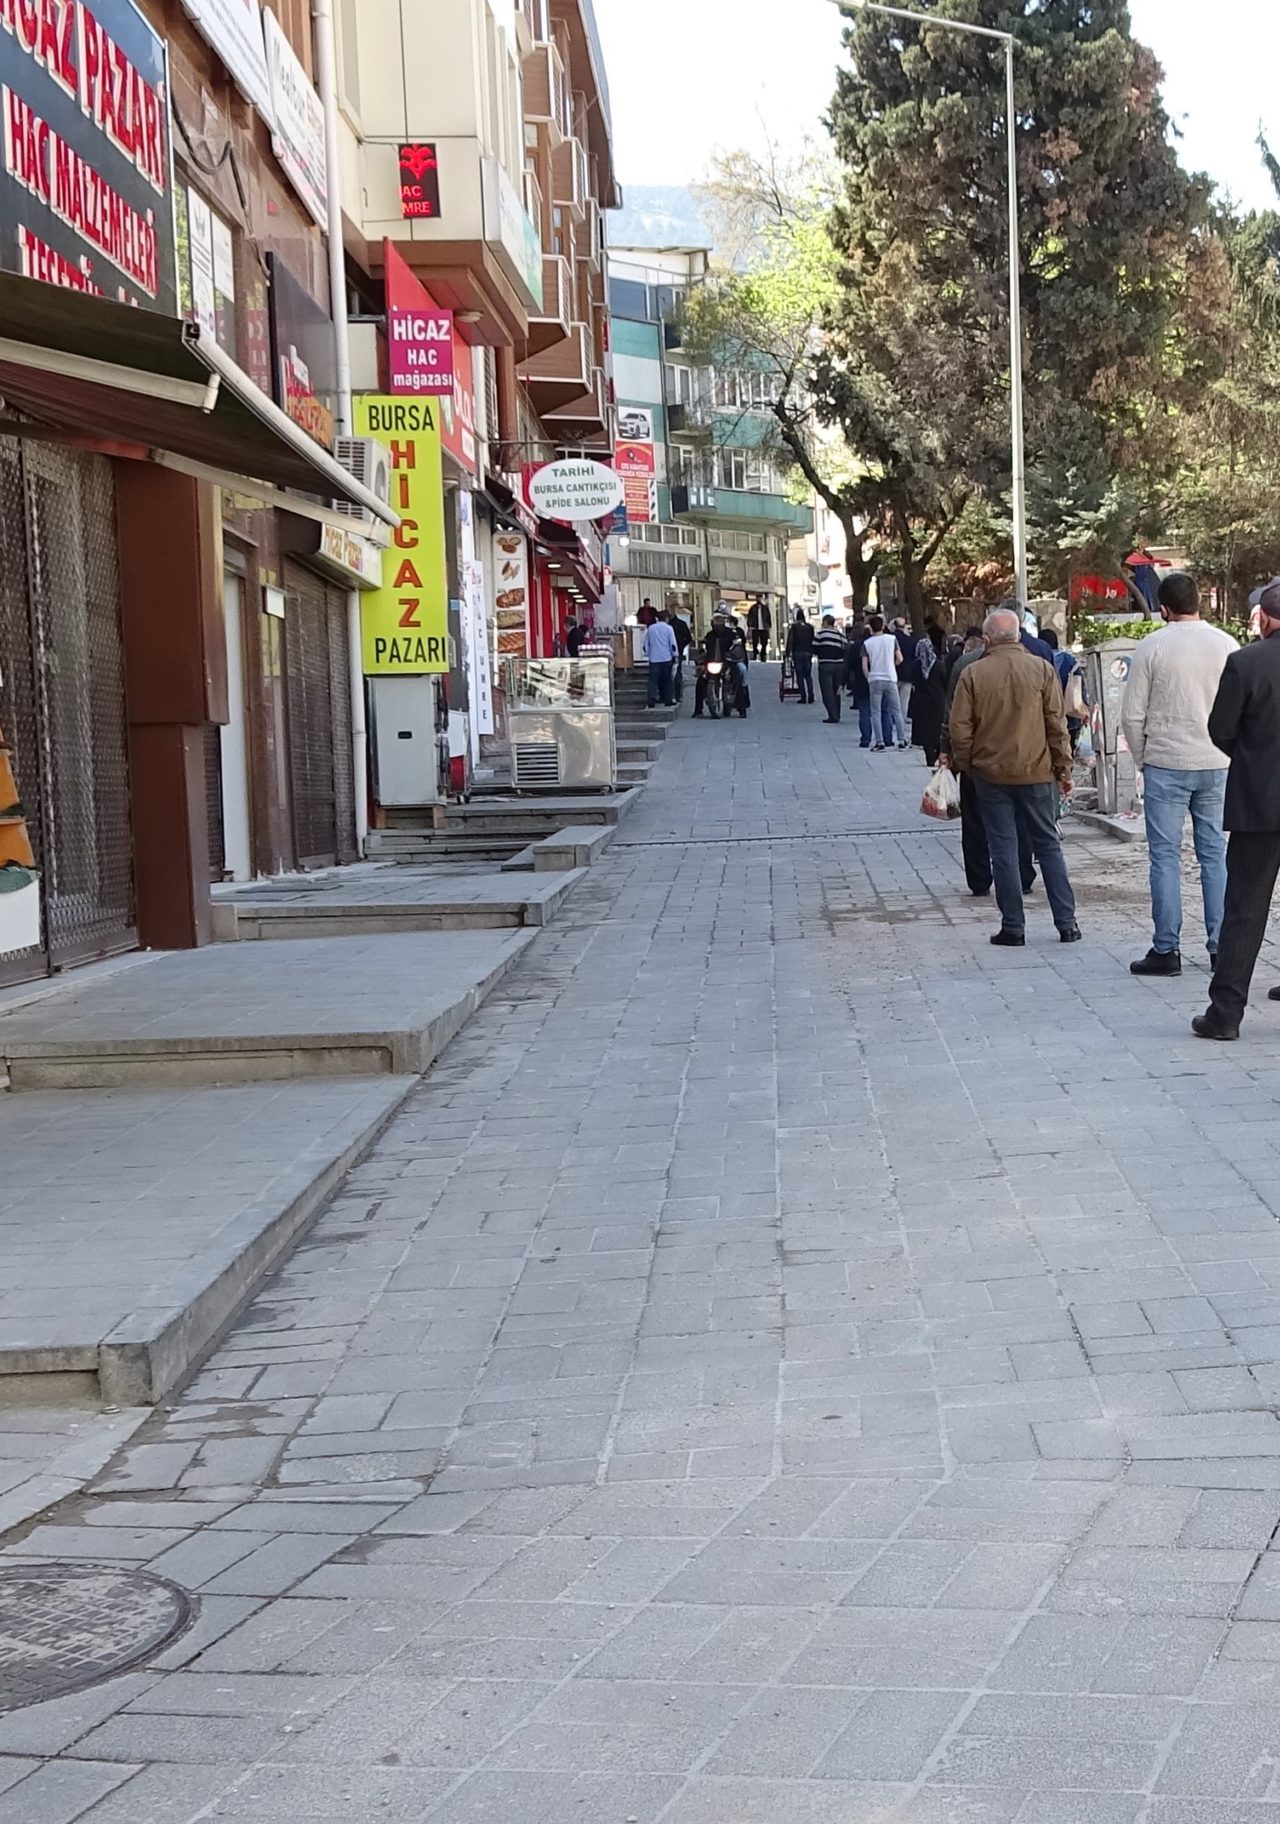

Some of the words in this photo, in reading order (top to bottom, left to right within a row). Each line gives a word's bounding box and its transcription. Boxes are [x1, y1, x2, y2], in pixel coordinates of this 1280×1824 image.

[2, 83, 51, 206] HAC
[398, 185, 422, 199] AC
[393, 314, 451, 341] HİCAZ
[407, 348, 438, 366] HAC
[393, 370, 452, 390] mağazası
[368, 404, 435, 431] BURSA
[551, 465, 595, 478] TARİHİ
[533, 484, 564, 495] BURSA
[574, 496, 610, 507] SALONU
[375, 637, 447, 663] PAZARI
